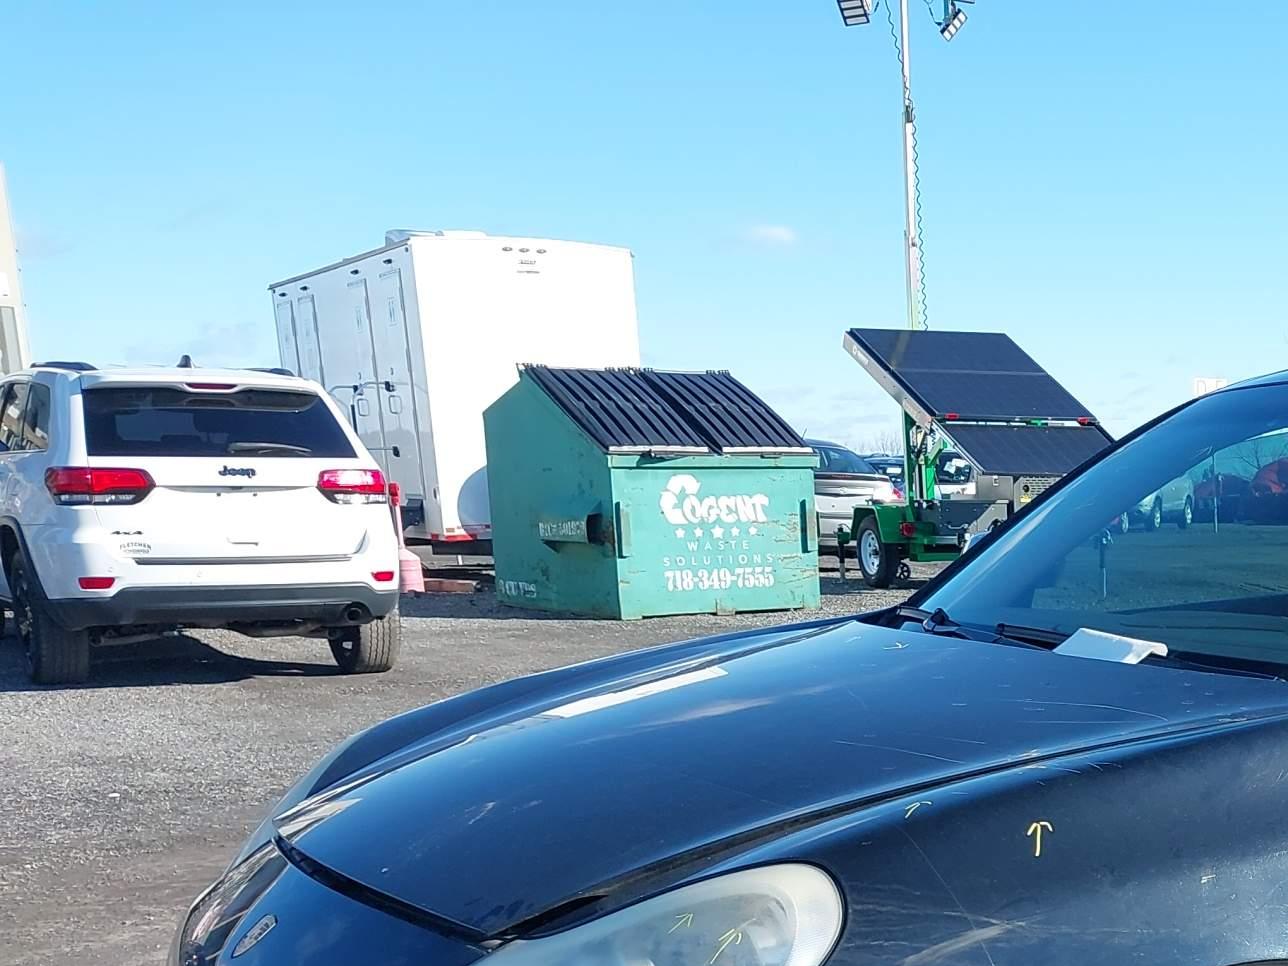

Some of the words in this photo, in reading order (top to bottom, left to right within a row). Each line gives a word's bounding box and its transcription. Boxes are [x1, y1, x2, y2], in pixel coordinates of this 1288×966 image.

[218, 465, 256, 478] Jeep
[687, 540, 750, 552] WASTE
[663, 553, 775, 568] SOLUTIONS
[664, 566, 775, 592] 718-349-7555
